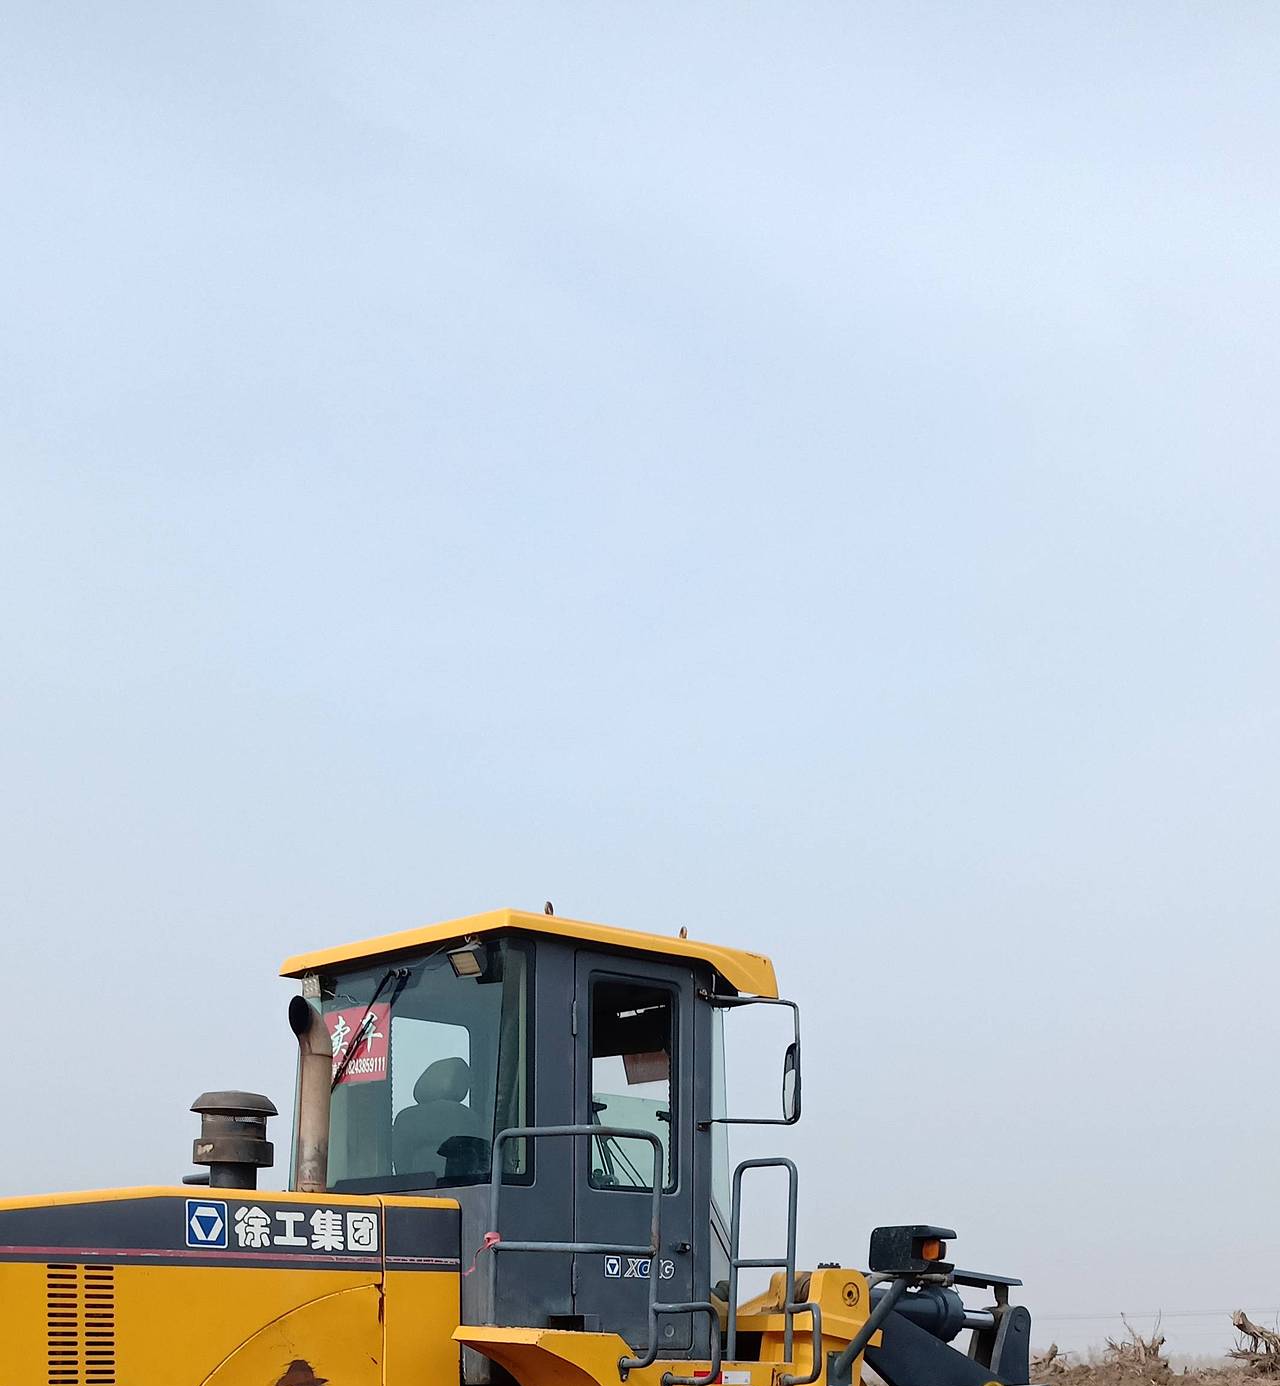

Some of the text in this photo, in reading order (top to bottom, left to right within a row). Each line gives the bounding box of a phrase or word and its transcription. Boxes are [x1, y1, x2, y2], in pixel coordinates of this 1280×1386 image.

[234, 1206, 378, 1252] 徐工集团
[624, 1258, 675, 1279] XCG
